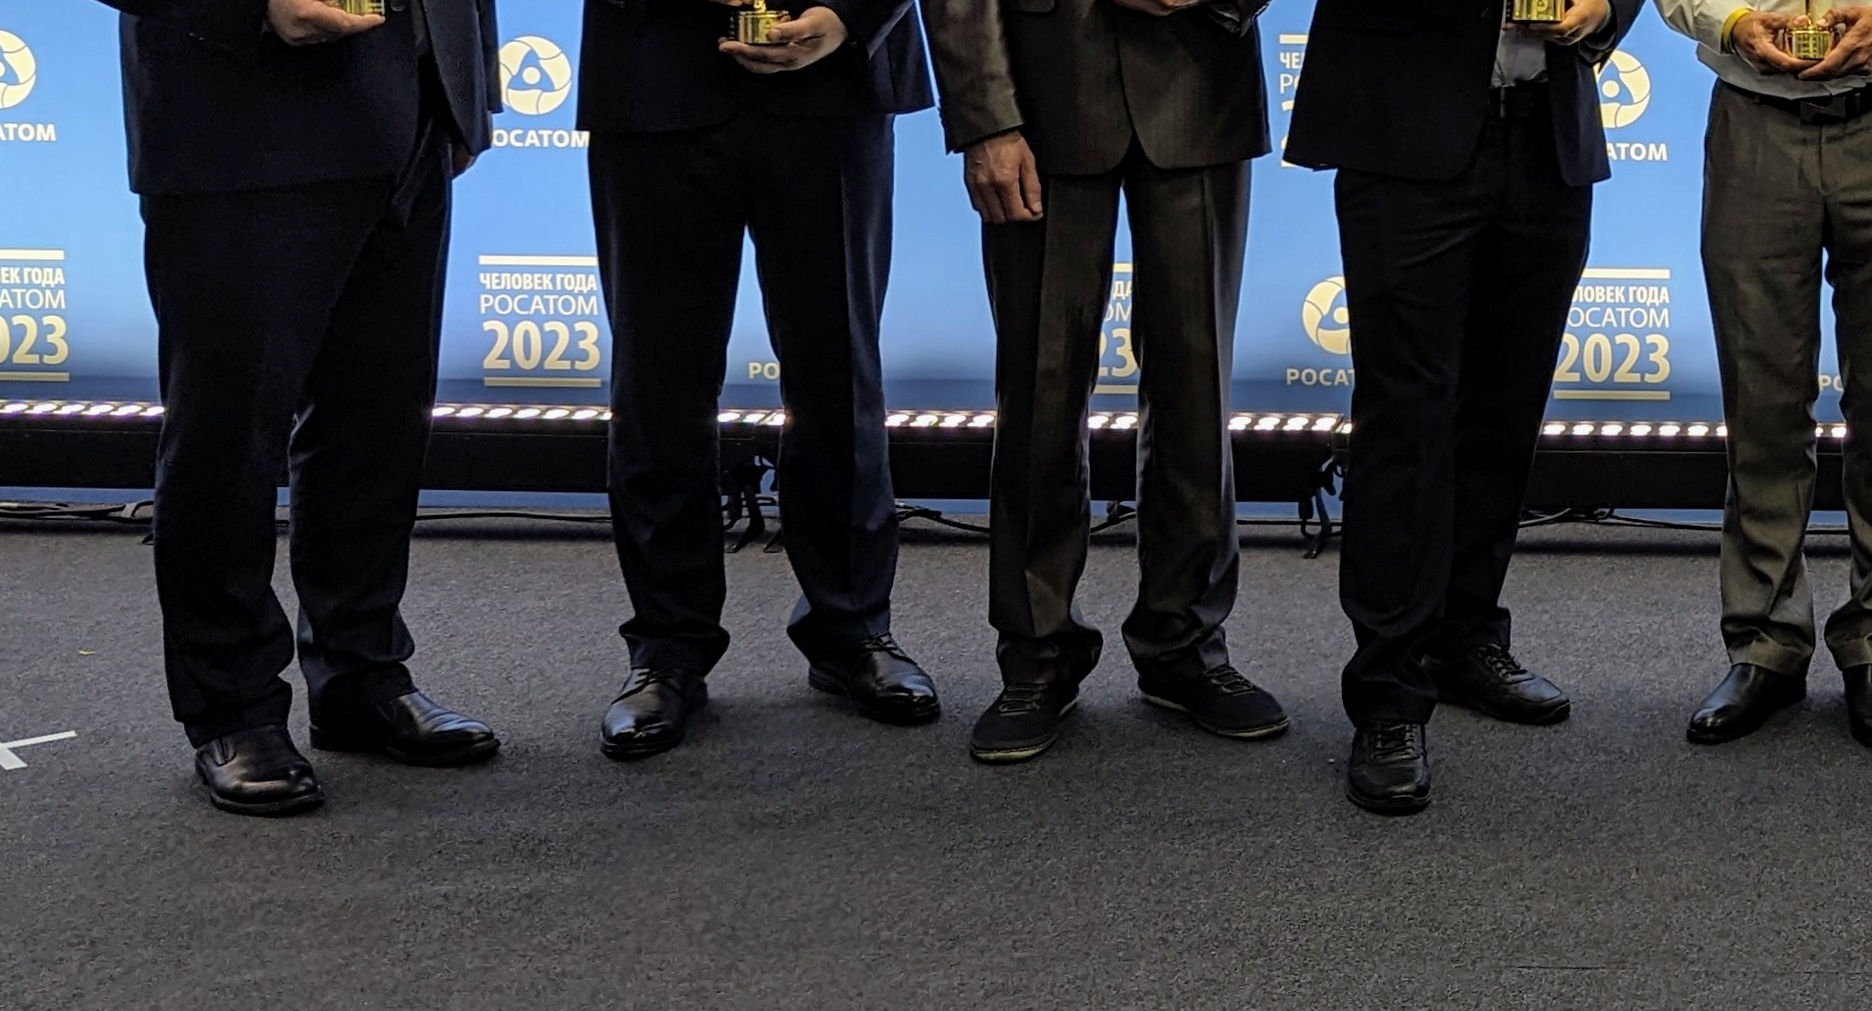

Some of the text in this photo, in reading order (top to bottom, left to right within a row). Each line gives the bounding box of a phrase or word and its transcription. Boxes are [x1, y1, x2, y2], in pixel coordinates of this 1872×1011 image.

[493, 128, 590, 149] ОСАТОМ
[1606, 142, 1668, 162] АТОМ
[23, 268, 64, 286] ГОДА
[480, 274, 596, 293] ЧЕЛОВЕК ГОДА
[480, 291, 598, 315] РОСАТОМ
[1572, 286, 1669, 305] ЛОВЕК ГОДА
[1567, 307, 1670, 330] ОСАТОМ
[0, 315, 68, 366] 23
[484, 321, 600, 371] 2023
[1553, 331, 1670, 384] 2023
